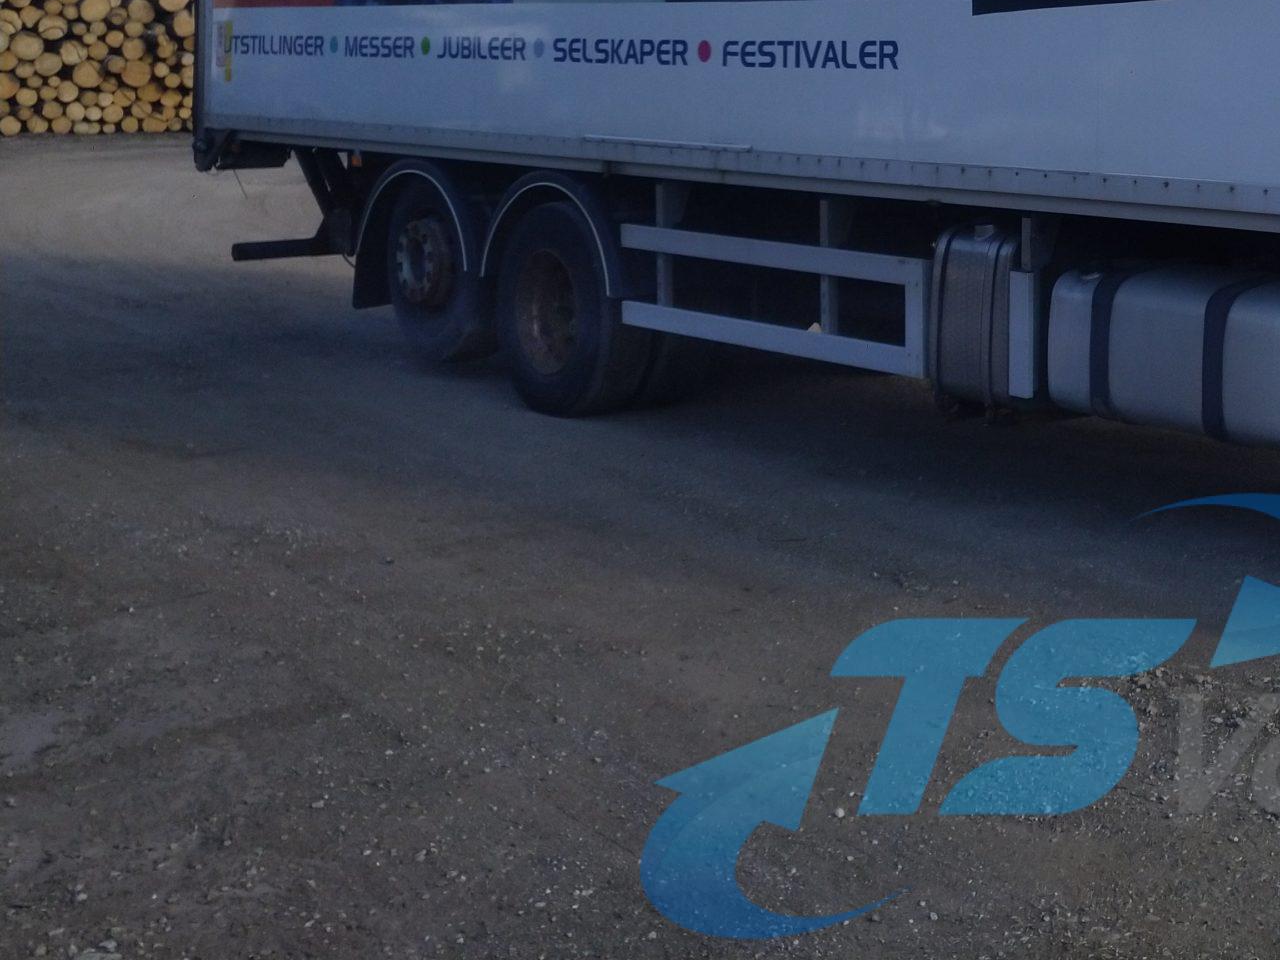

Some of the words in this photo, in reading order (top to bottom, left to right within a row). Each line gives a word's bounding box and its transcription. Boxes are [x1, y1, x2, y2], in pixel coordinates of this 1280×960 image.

[344, 35, 415, 58] MESSER
[436, 35, 527, 61] JUBILEER
[552, 37, 689, 66] SELSKAPER
[721, 40, 900, 70] FESTIVALER
